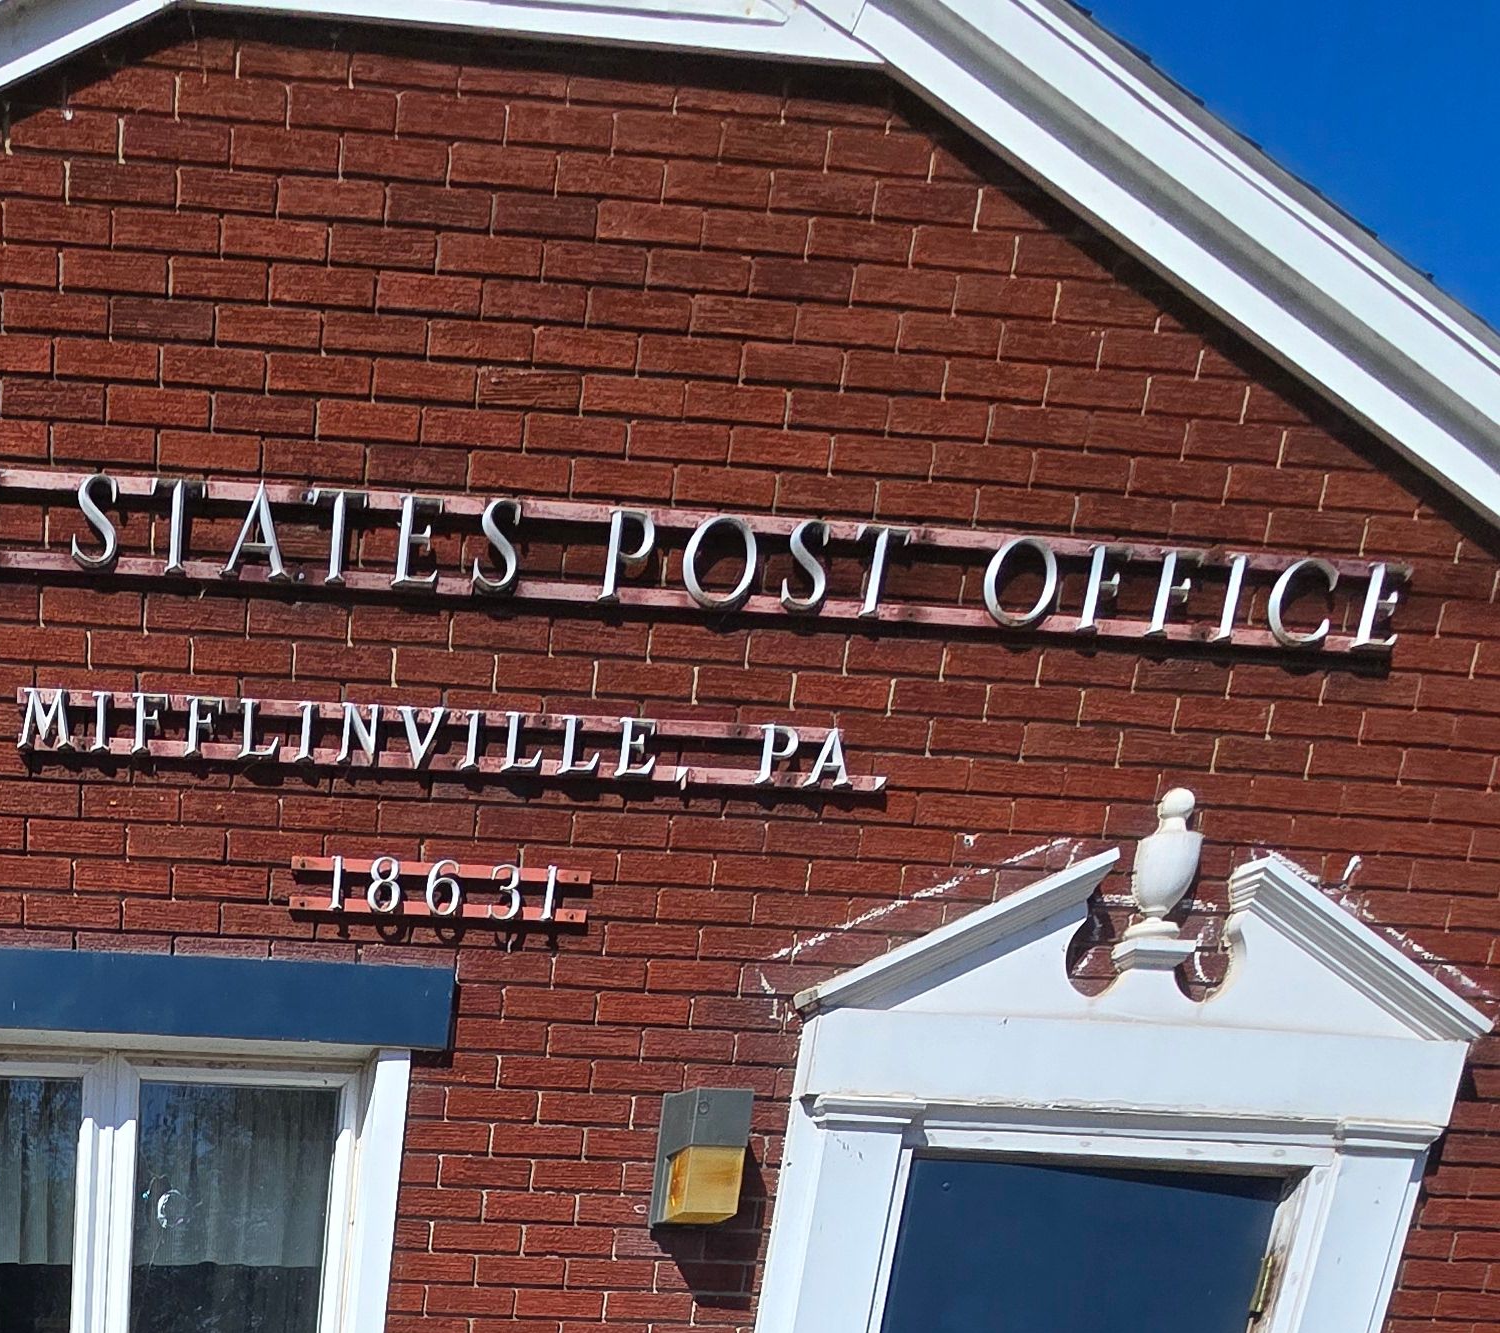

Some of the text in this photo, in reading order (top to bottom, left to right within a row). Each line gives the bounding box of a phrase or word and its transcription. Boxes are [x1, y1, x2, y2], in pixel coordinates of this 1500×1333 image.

[71, 472, 522, 597] STATES
[598, 508, 912, 619] POST
[983, 535, 1414, 652] OFFICE
[328, 855, 558, 921] 18631
